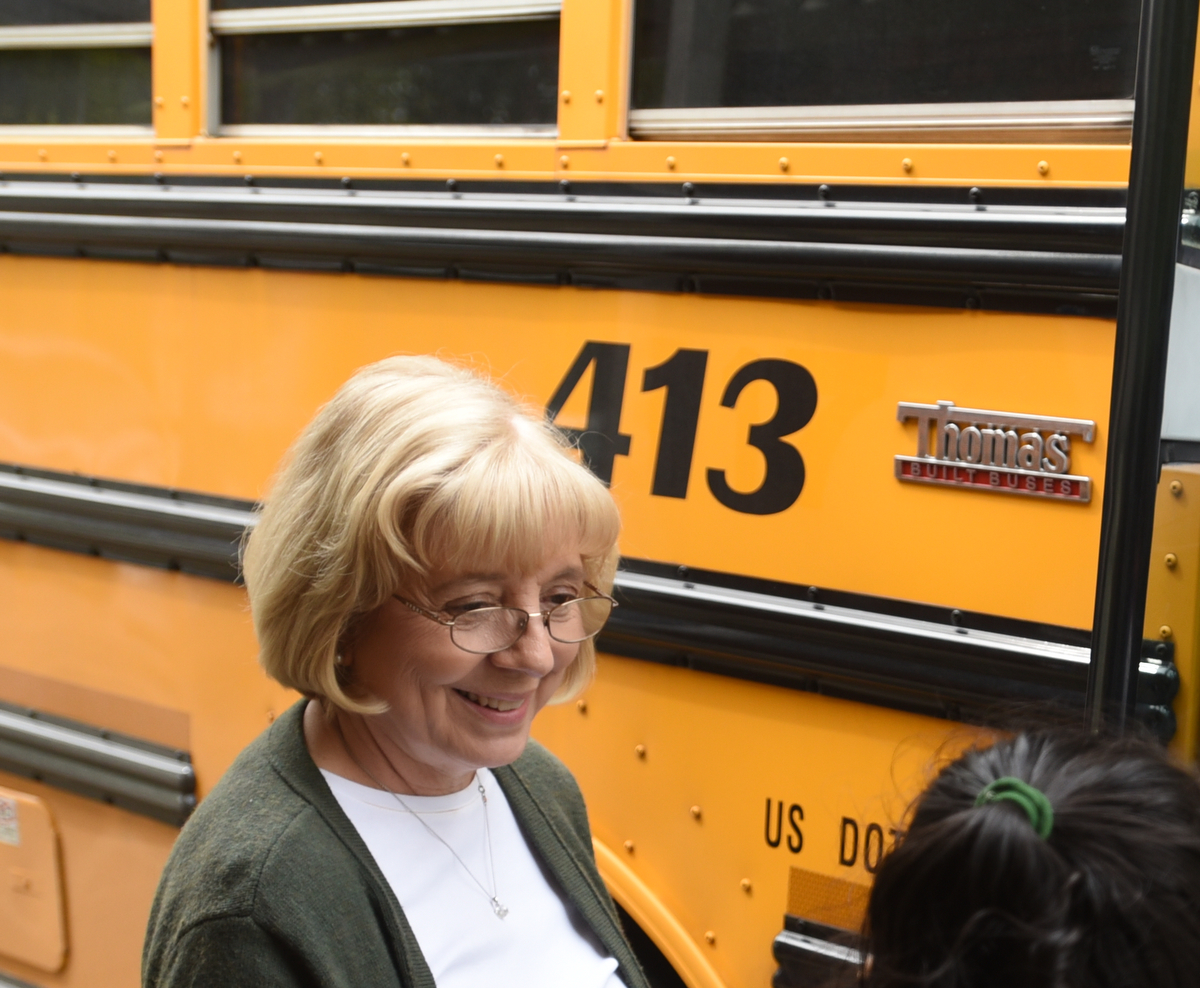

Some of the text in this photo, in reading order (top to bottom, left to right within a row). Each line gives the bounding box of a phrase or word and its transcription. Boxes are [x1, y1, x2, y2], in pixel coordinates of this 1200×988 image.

[545, 340, 819, 515] 413
[897, 400, 1095, 474] Thomas
[910, 462, 1071, 495] BUILT BUSES
[765, 797, 804, 854] US
